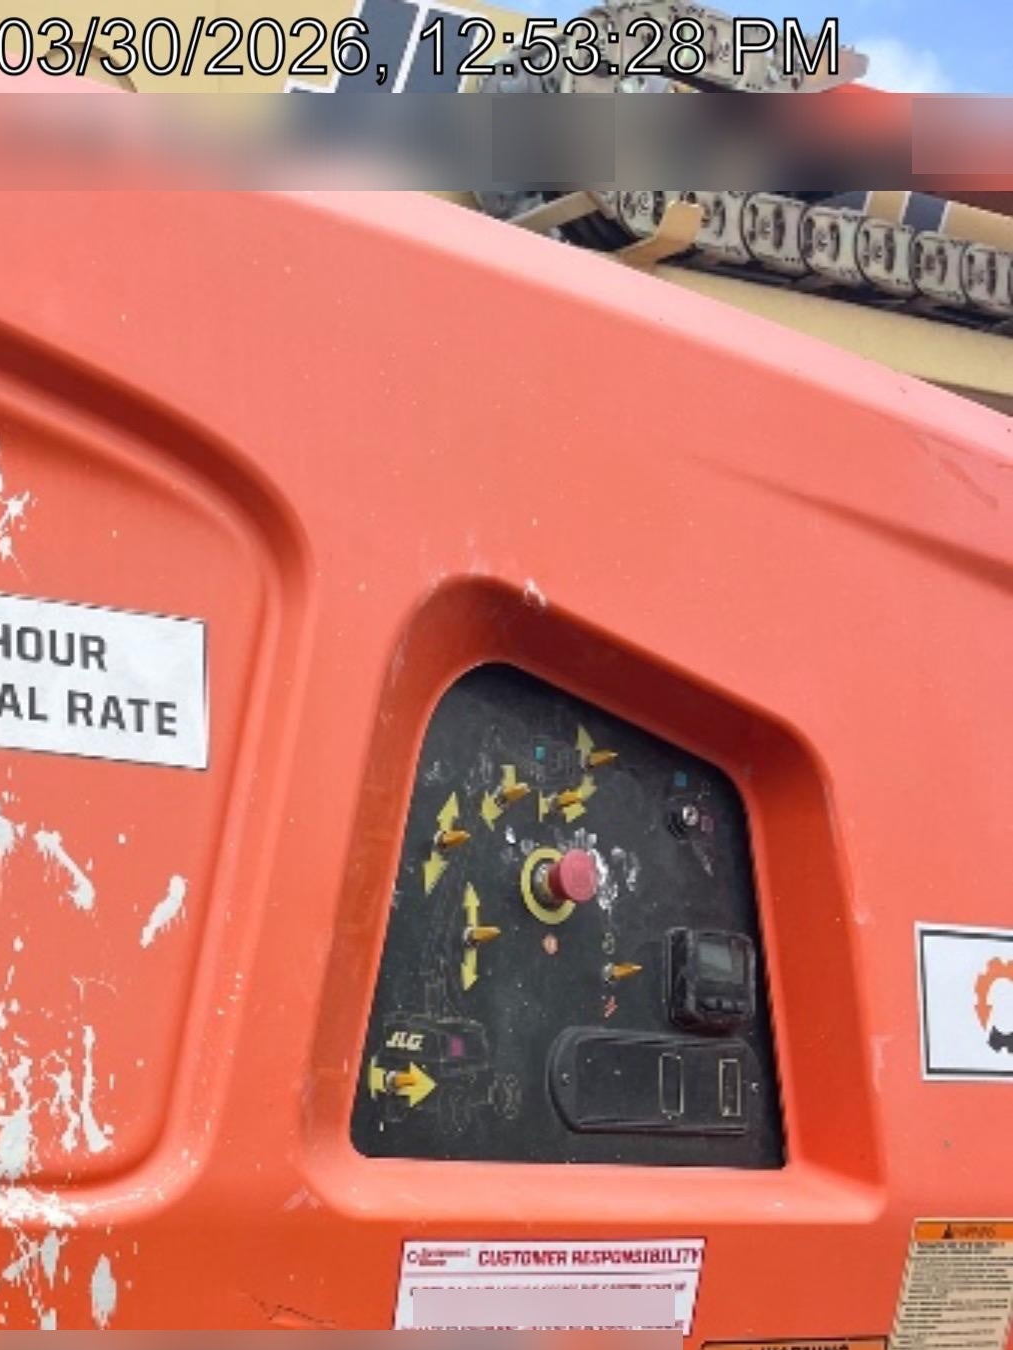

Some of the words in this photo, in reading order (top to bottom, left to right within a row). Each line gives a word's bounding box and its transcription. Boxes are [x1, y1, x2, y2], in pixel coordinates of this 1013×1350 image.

[67, 691, 178, 737] RATE
[385, 1031, 425, 1052] JLG
[478, 1249, 567, 1267] CUSTOMER
